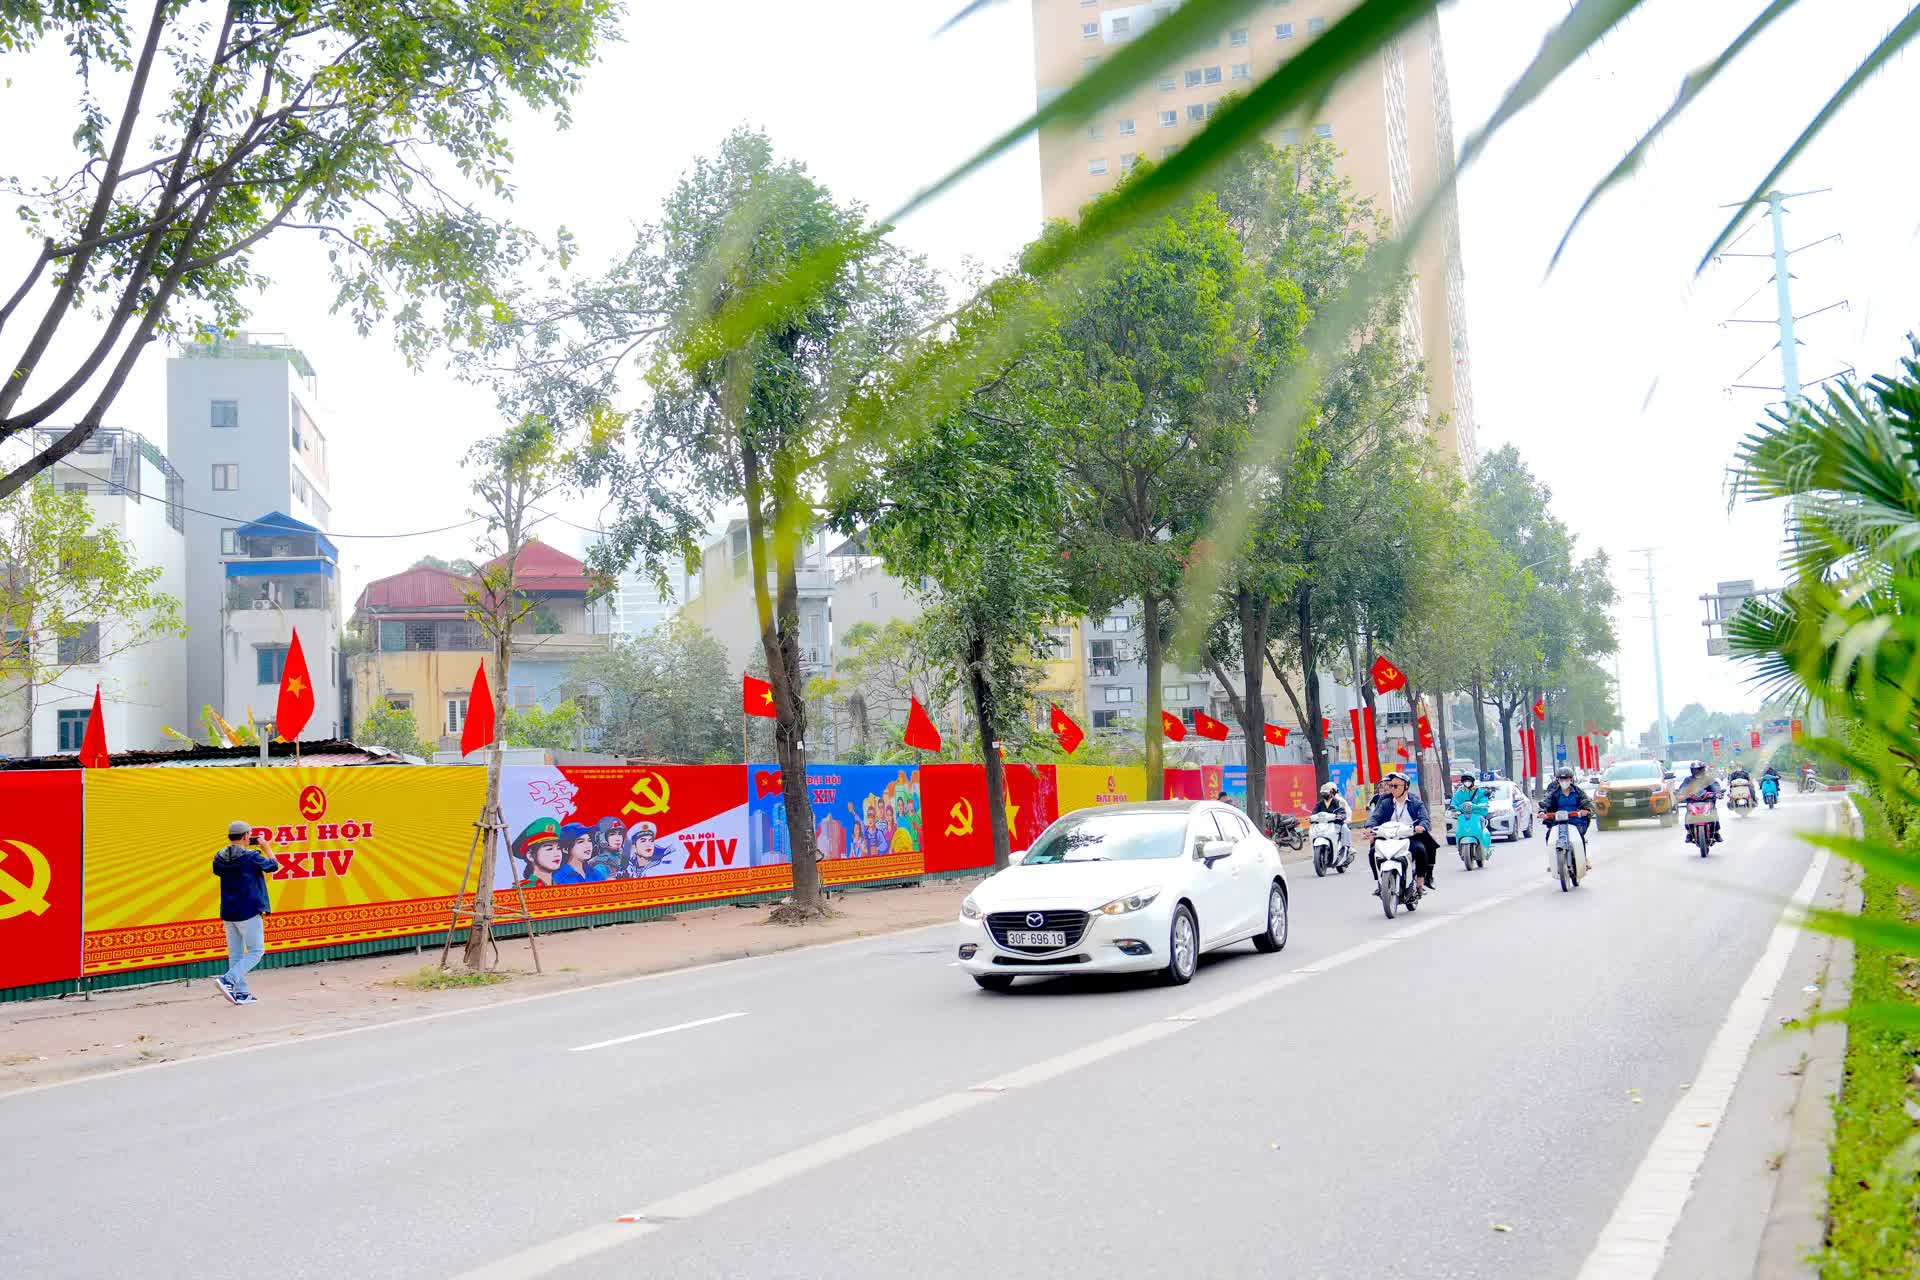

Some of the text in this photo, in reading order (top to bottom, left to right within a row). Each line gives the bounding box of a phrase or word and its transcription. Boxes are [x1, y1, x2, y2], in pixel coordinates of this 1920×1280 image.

[813, 789, 836, 803] XIV
[317, 819, 373, 842] HỘI
[272, 849, 354, 880] XIV
[683, 838, 738, 869] XIV
[1009, 933, 1064, 945] 30F-696.19
